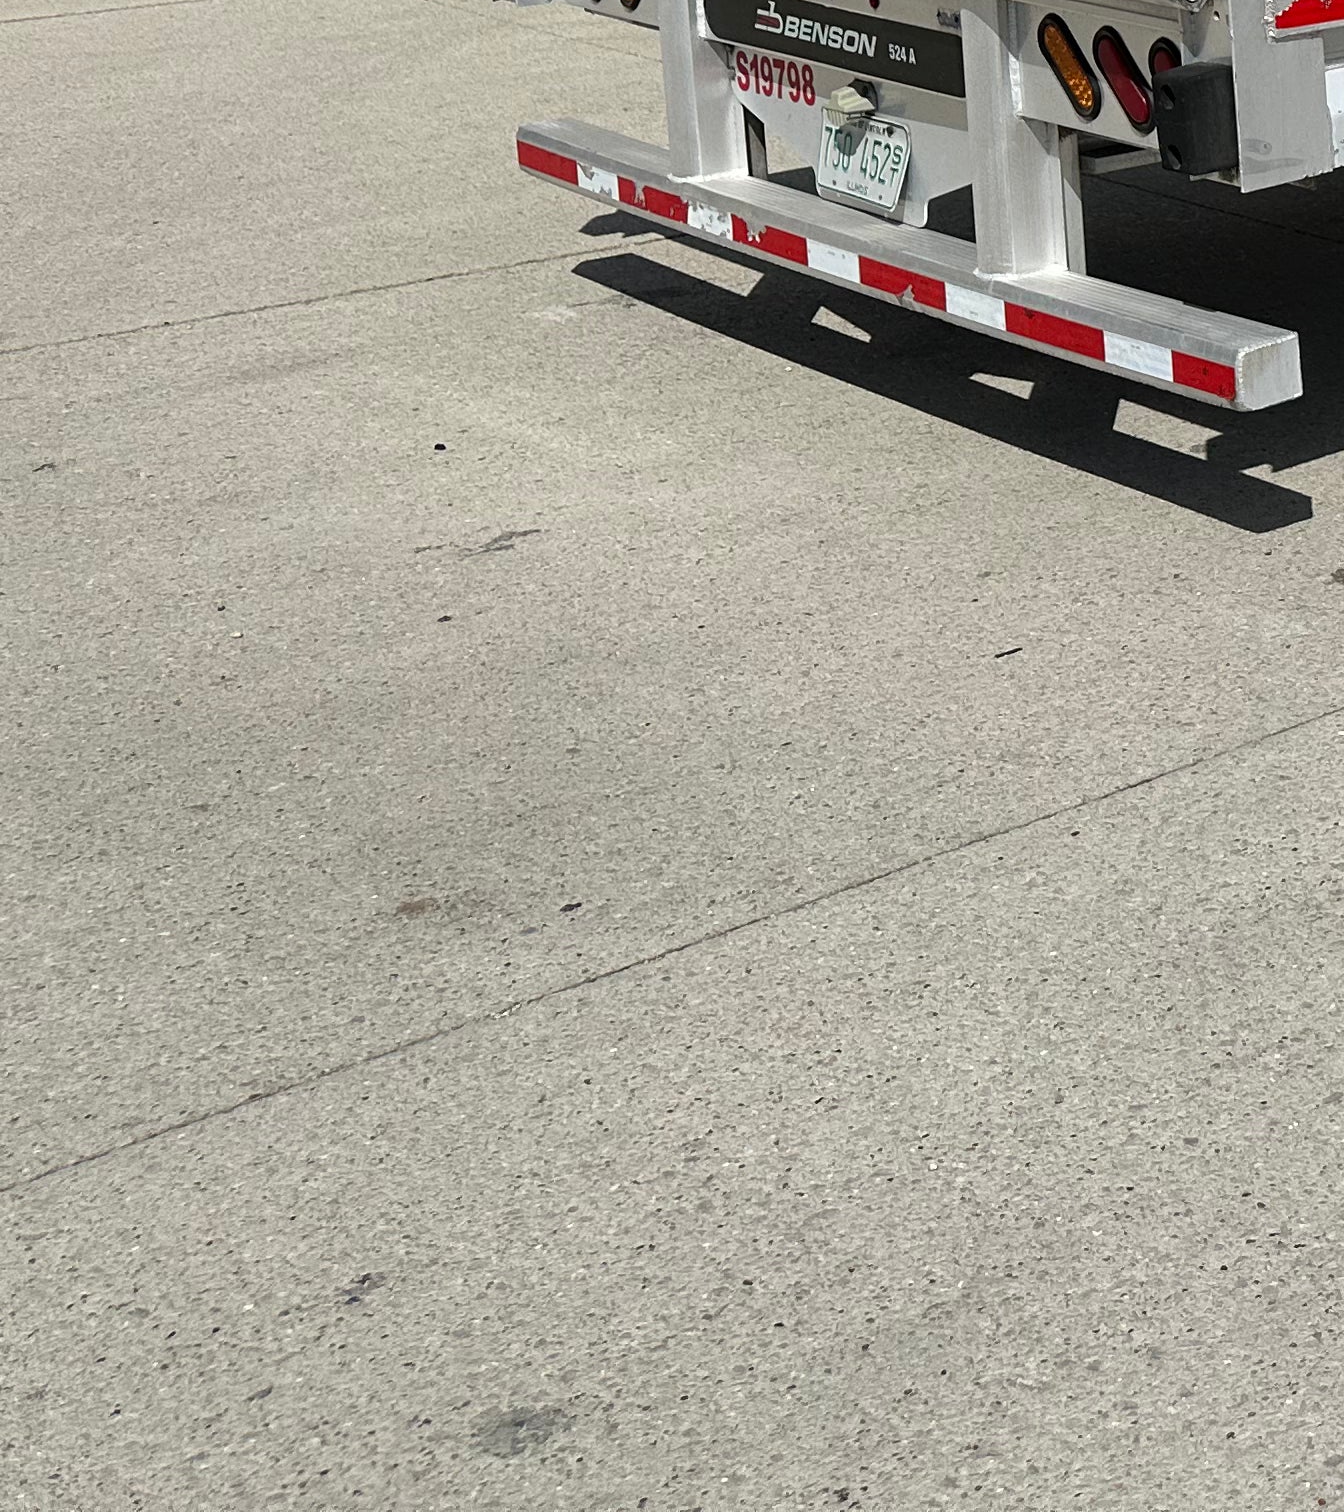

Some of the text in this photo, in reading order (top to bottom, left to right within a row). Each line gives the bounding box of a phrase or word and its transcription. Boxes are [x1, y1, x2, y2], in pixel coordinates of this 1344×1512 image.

[784, 15, 877, 58] BENSON
[888, 42, 907, 62] 524
[736, 50, 817, 107] S19798
[860, 136, 891, 186] 452
